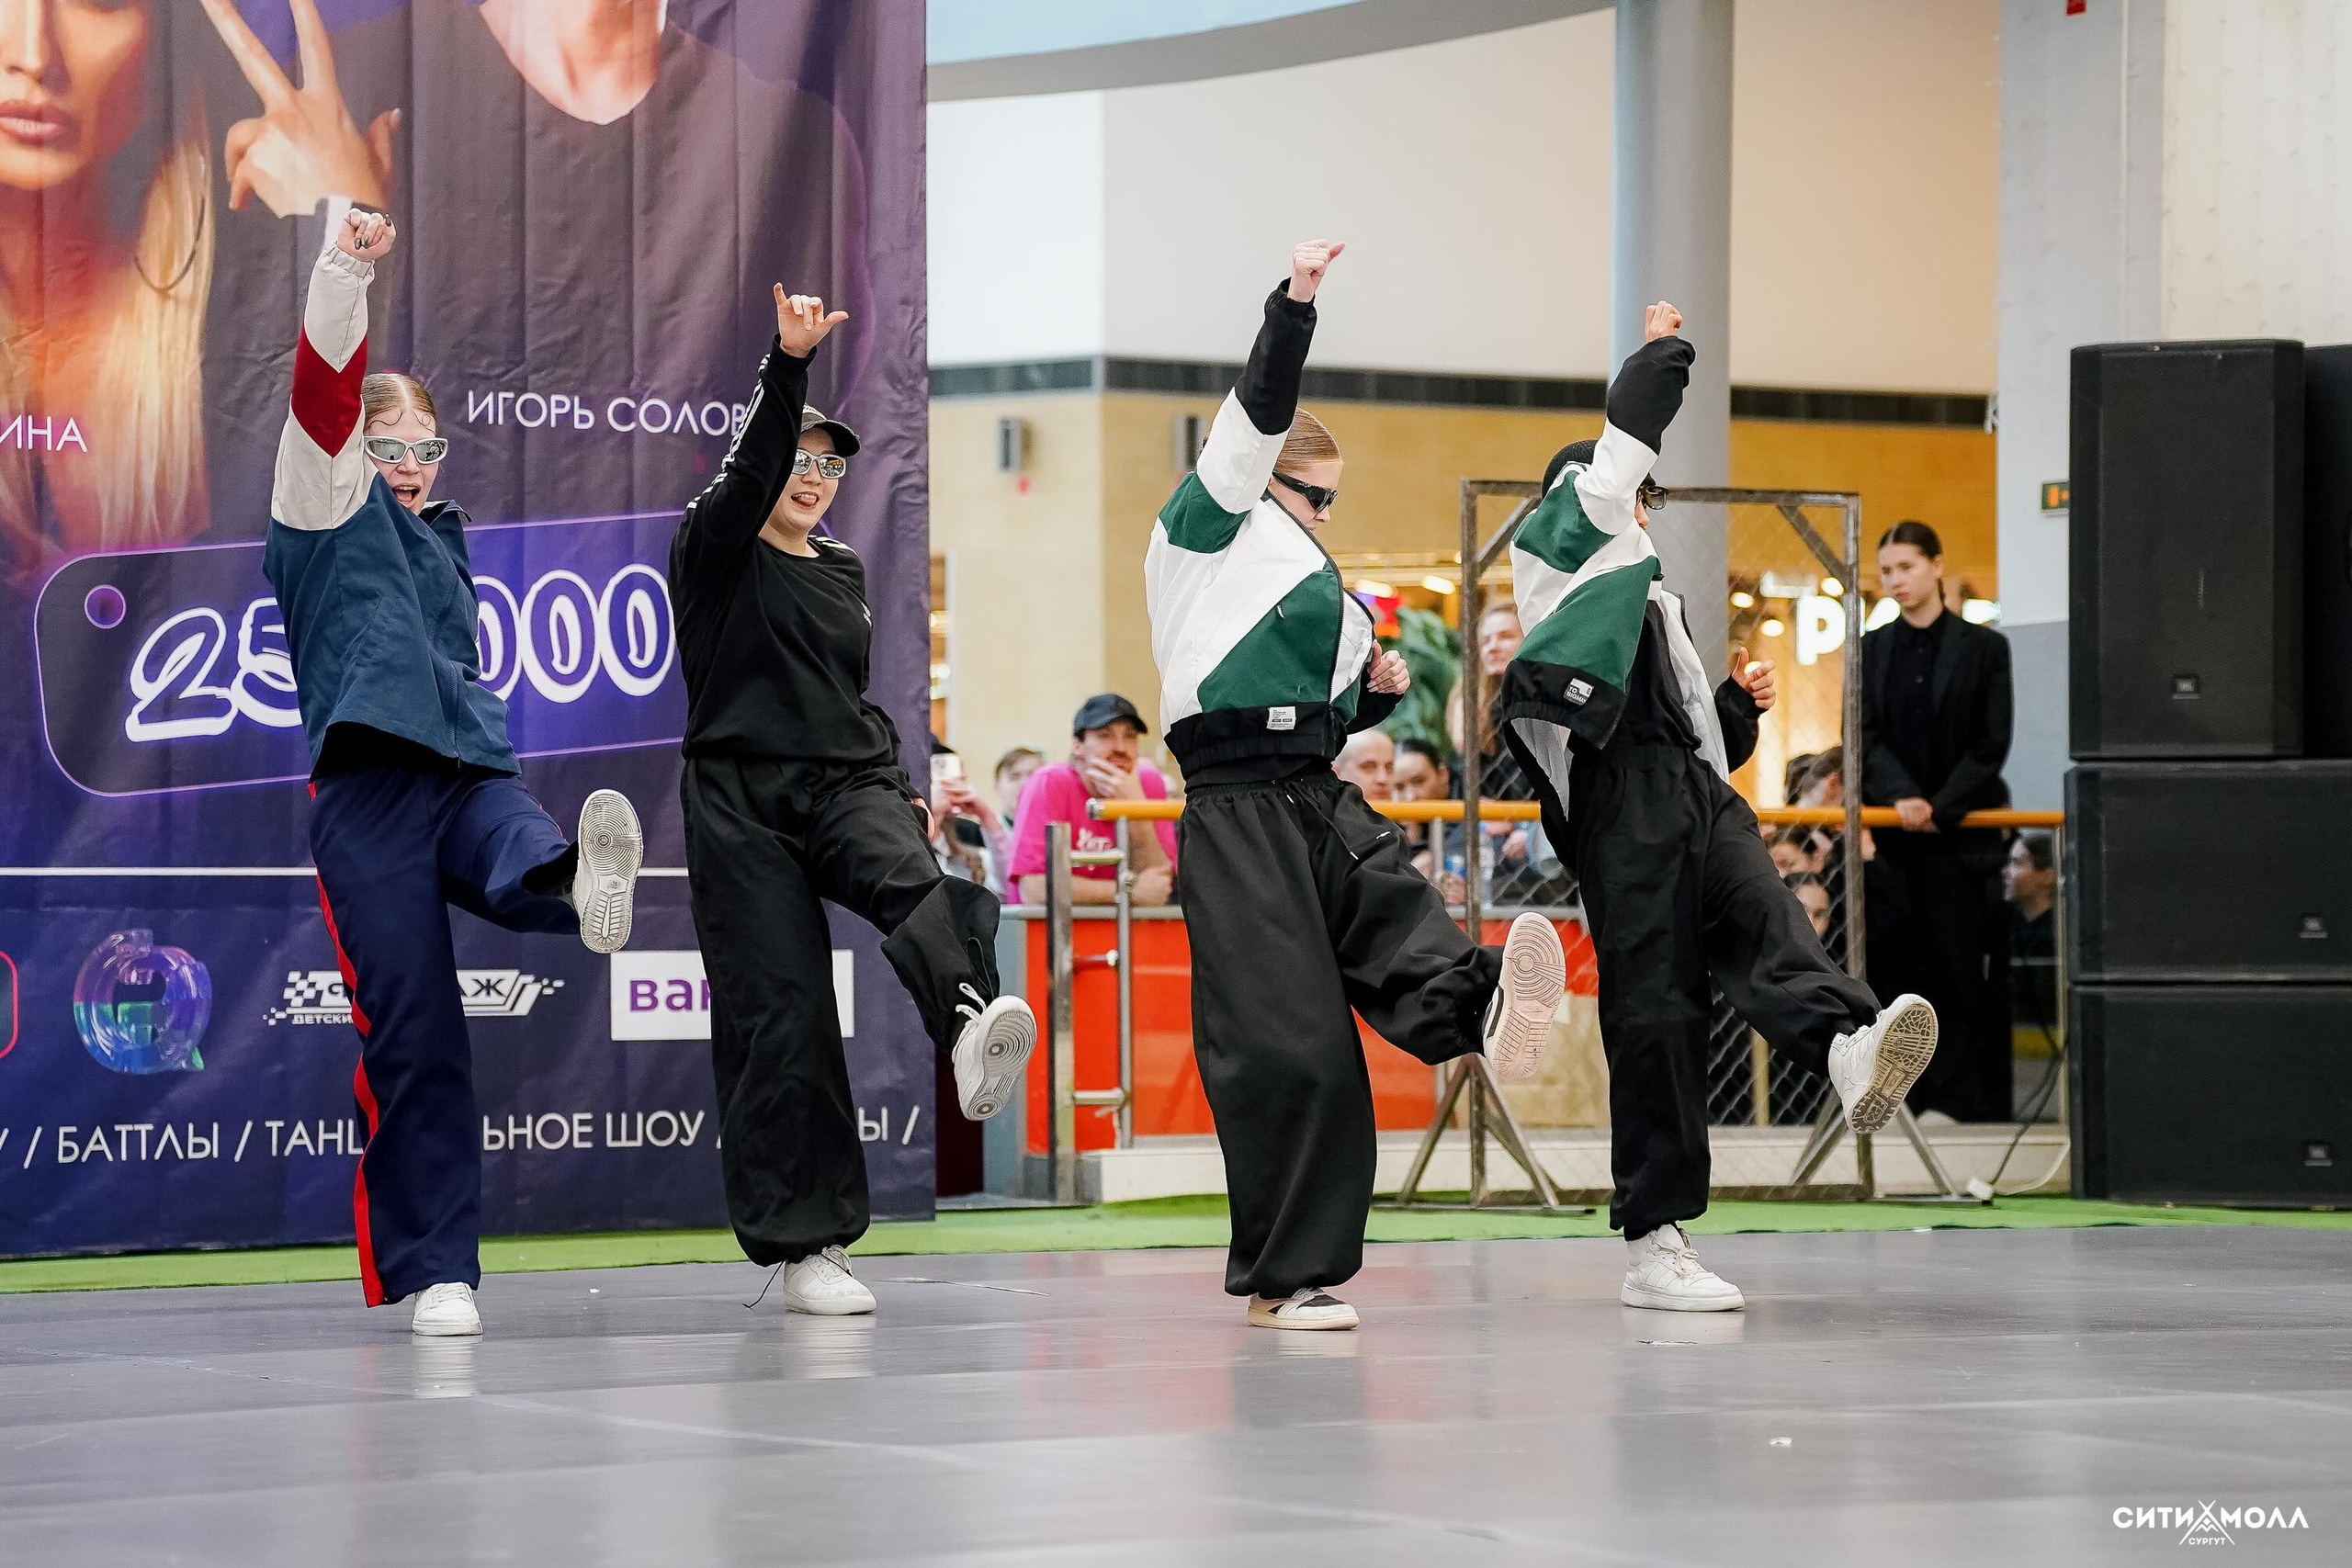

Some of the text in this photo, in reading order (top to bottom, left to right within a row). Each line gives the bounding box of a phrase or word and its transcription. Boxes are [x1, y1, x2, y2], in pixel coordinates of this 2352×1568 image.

[468, 389, 595, 429] ИГОРЬ
[0, 414, 88, 453] ИНА
[58, 1122, 219, 1164] БАТТЛЫ
[605, 1110, 705, 1148] ШОУ
